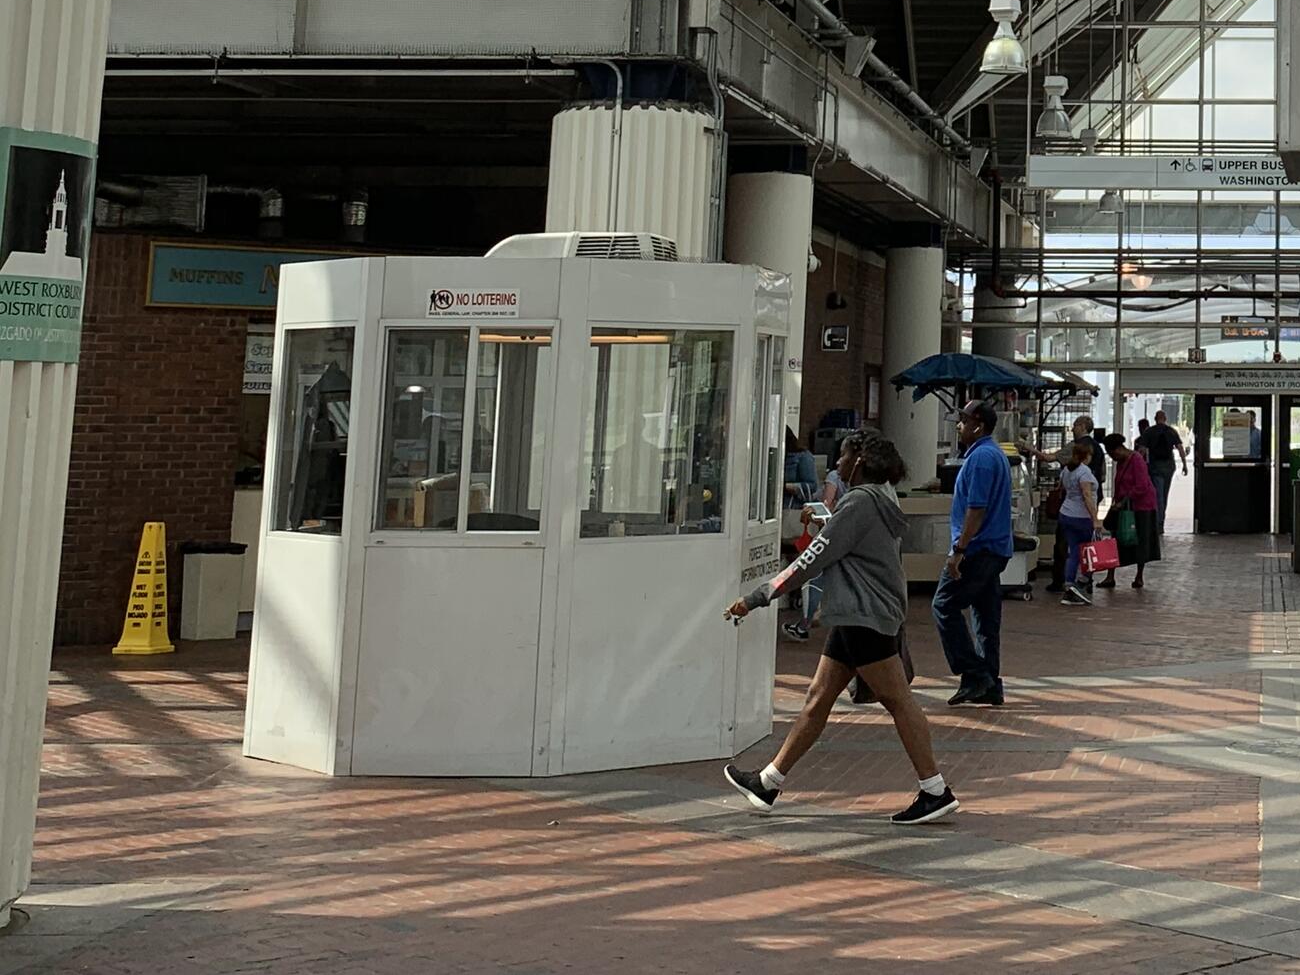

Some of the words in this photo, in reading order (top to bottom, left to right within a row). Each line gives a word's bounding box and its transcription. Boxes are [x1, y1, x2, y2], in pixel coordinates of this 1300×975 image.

[1219, 161, 1257, 170] UPPER
[168, 268, 244, 284] MUFFINS
[0, 281, 39, 296] WEST
[456, 293, 470, 306] NO
[472, 293, 517, 306] LOITERING
[0, 301, 53, 317] DISTRICT
